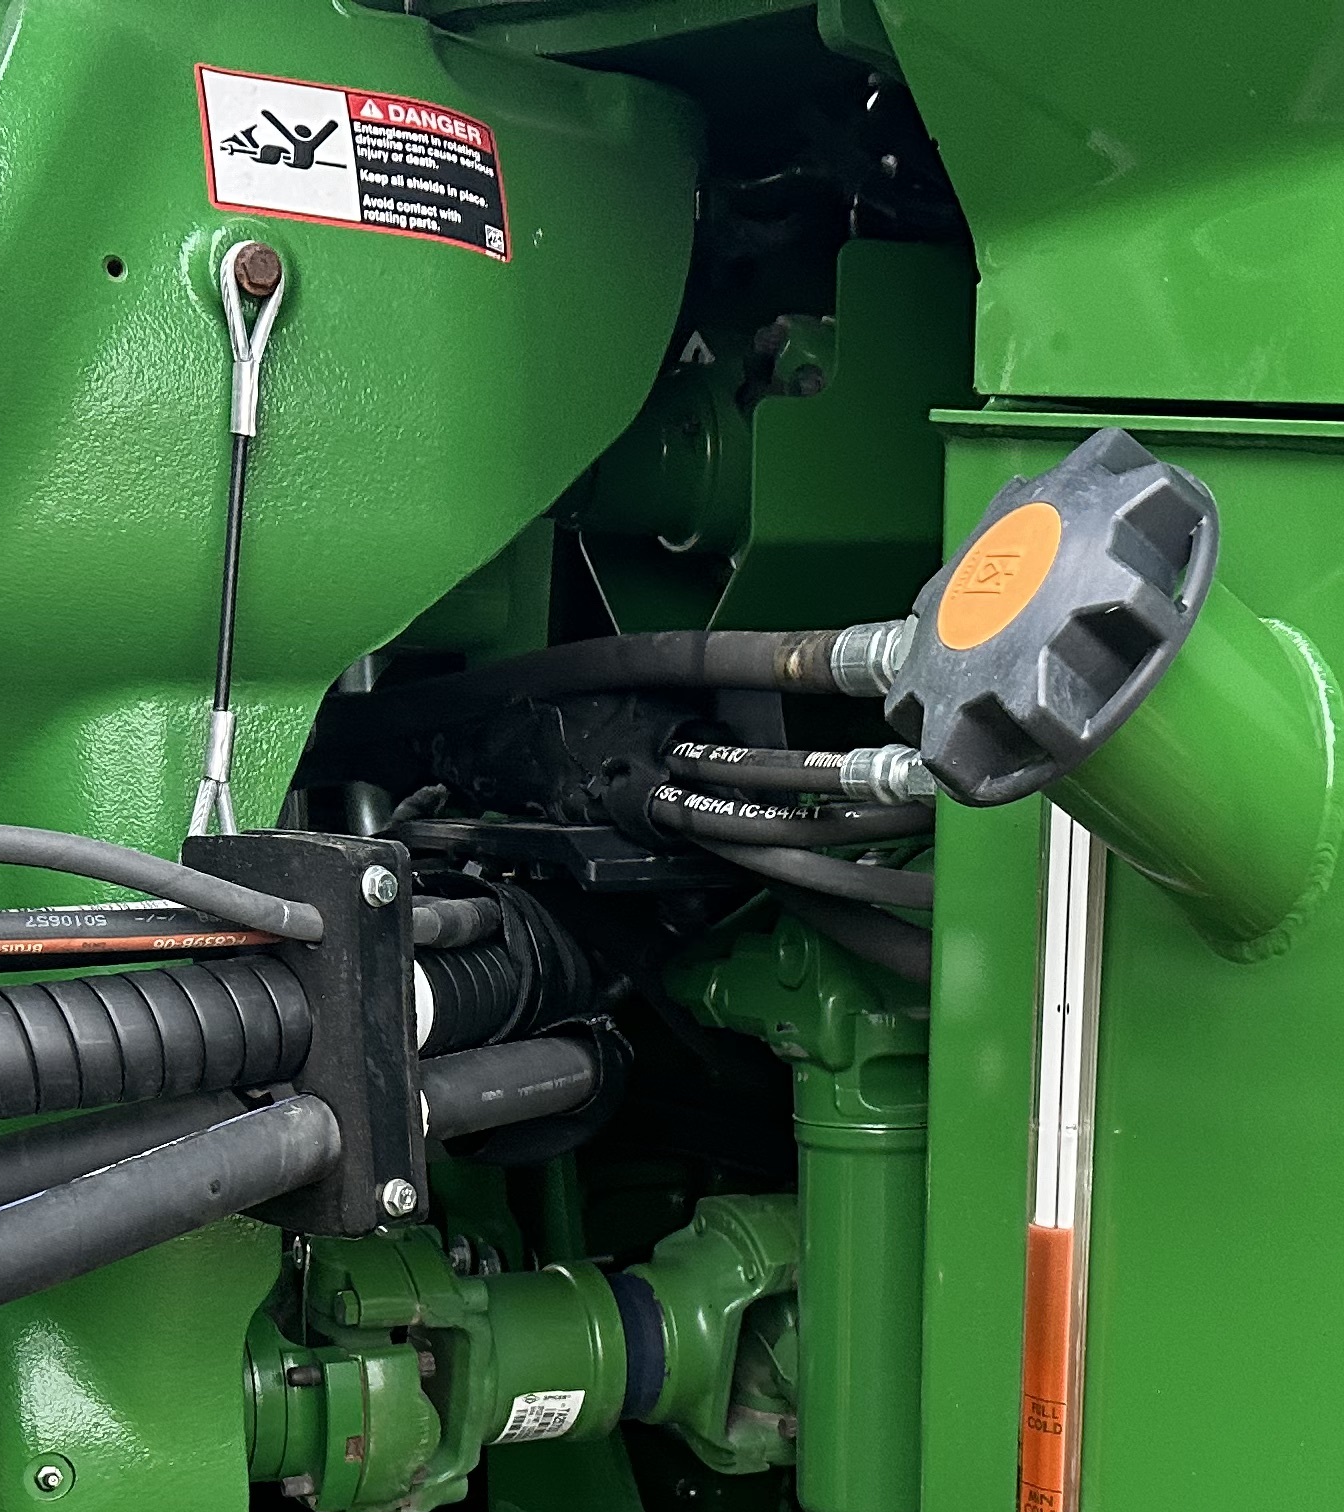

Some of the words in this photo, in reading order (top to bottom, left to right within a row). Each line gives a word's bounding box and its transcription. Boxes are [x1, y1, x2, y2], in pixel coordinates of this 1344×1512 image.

[387, 103, 482, 145] DANGER
[353, 121, 429, 145] Entanglement
[430, 137, 442, 147] in
[443, 140, 481, 161] rotating
[355, 133, 403, 150] driveline
[405, 144, 426, 155] can
[427, 147, 458, 163] cause
[460, 156, 495, 178] serious
[356, 145, 389, 163] injury
[391, 152, 404, 163] or
[405, 154, 440, 169] death.
[359, 168, 389, 187] Keep
[390, 174, 404, 188] all
[406, 177, 446, 195] shields
[447, 184, 458, 197] in
[459, 189, 489, 209] place.
[362, 194, 395, 211] Avoid
[396, 201, 438, 217] contact
[439, 207, 462, 224] with
[363, 210, 407, 229] rotating
[409, 216, 441, 233] parts.
[684, 793, 735, 816] MSHA
[25, 914, 107, 929] 5010657
[1027, 1416, 1063, 1435] COLD
